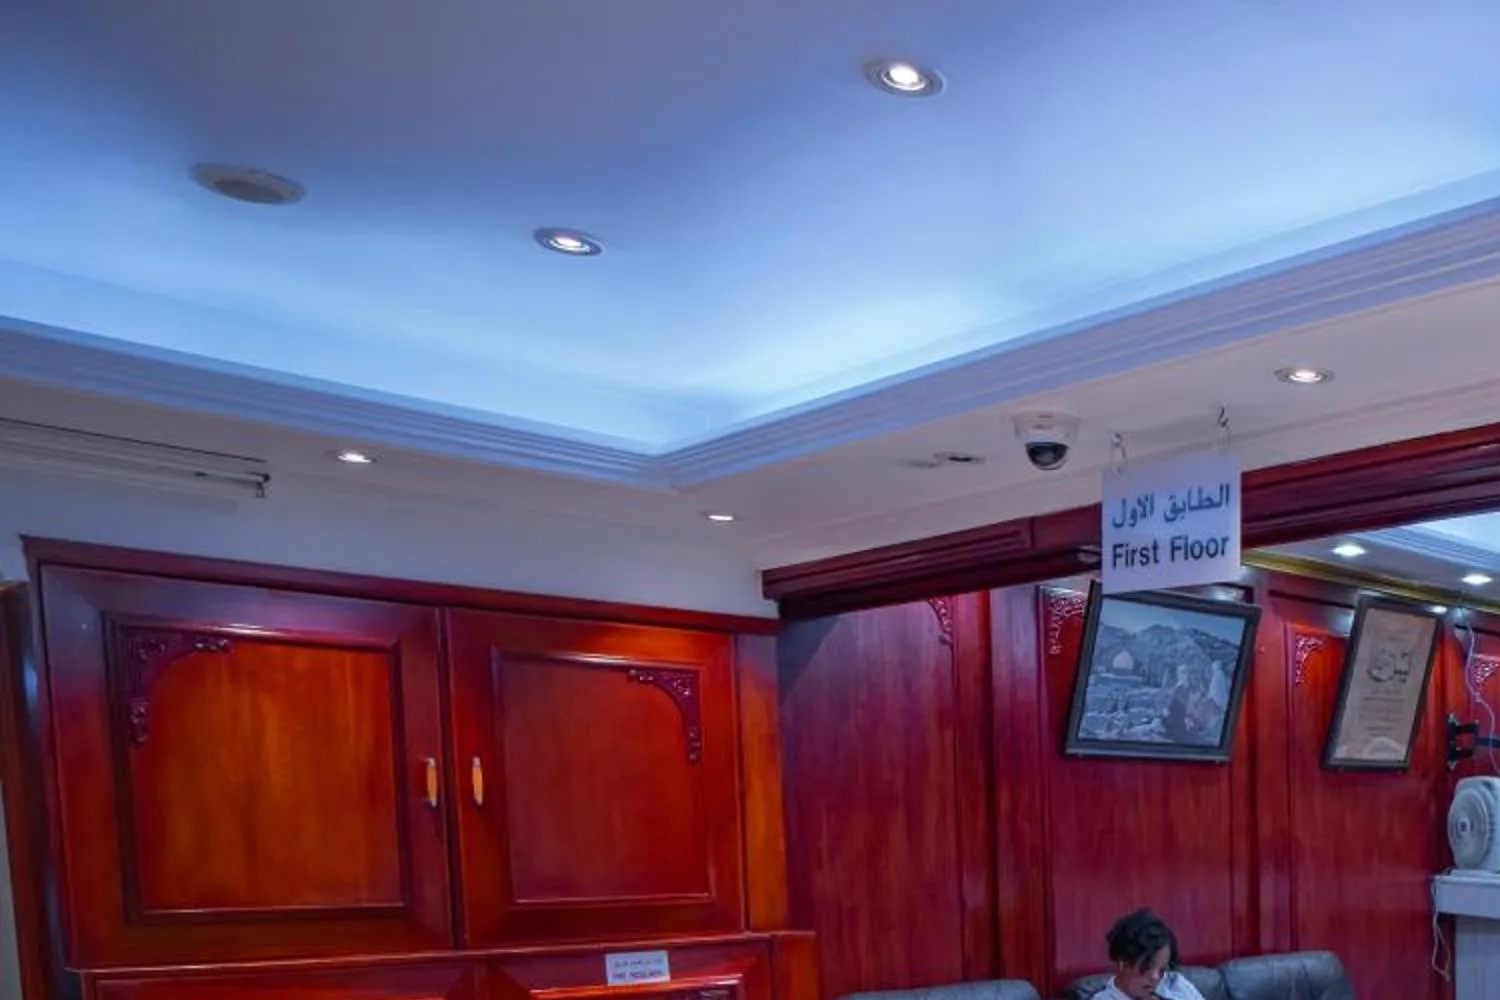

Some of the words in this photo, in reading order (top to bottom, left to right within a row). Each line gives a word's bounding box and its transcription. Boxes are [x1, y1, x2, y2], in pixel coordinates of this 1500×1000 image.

[1163, 482, 1231, 523] الطابق
[1112, 539, 1160, 570] First
[1170, 534, 1231, 562] Floor
